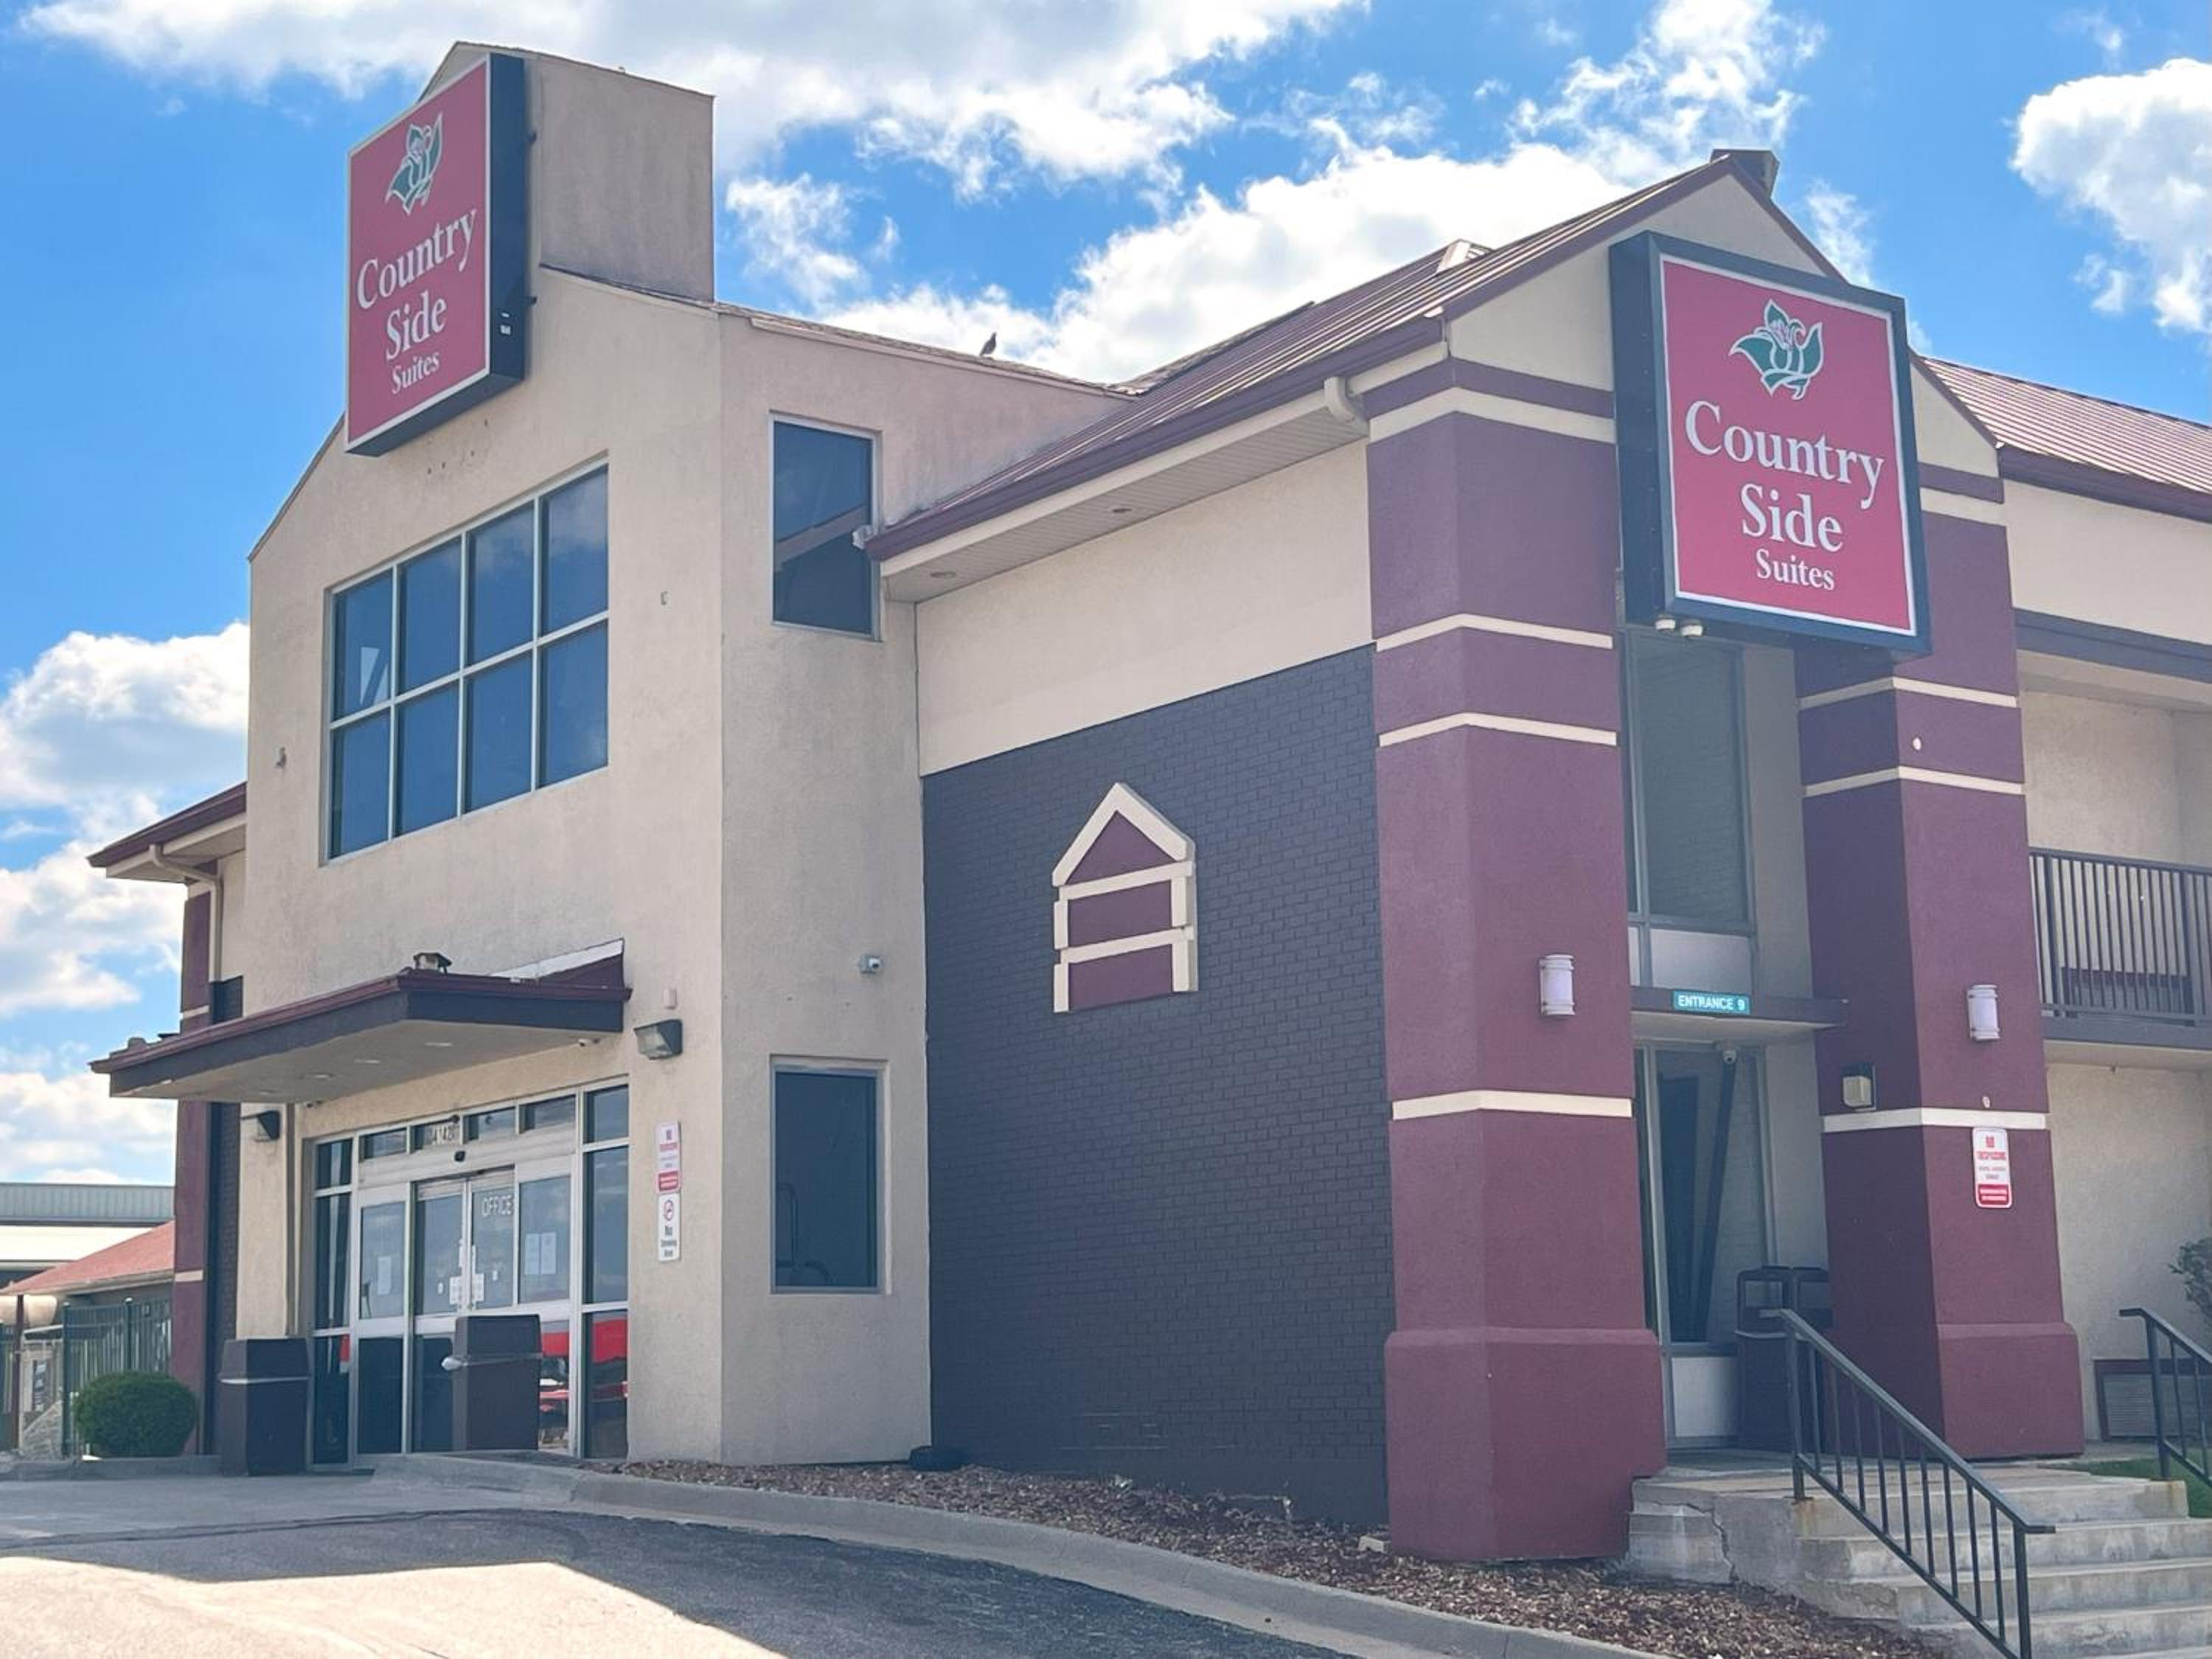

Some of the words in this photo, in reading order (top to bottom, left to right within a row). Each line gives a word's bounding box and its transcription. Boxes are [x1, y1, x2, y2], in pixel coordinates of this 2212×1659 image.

[357, 209, 477, 309] Country
[386, 290, 448, 361] Side
[392, 351, 440, 394] Suites
[1685, 400, 1885, 509] Country
[1740, 483, 1843, 552] Side
[1756, 549, 1835, 591] Suites
[1677, 995, 1733, 1010] ENTRANCE
[1737, 999, 1745, 1011] 9
[481, 1194, 512, 1217] OFFICE
